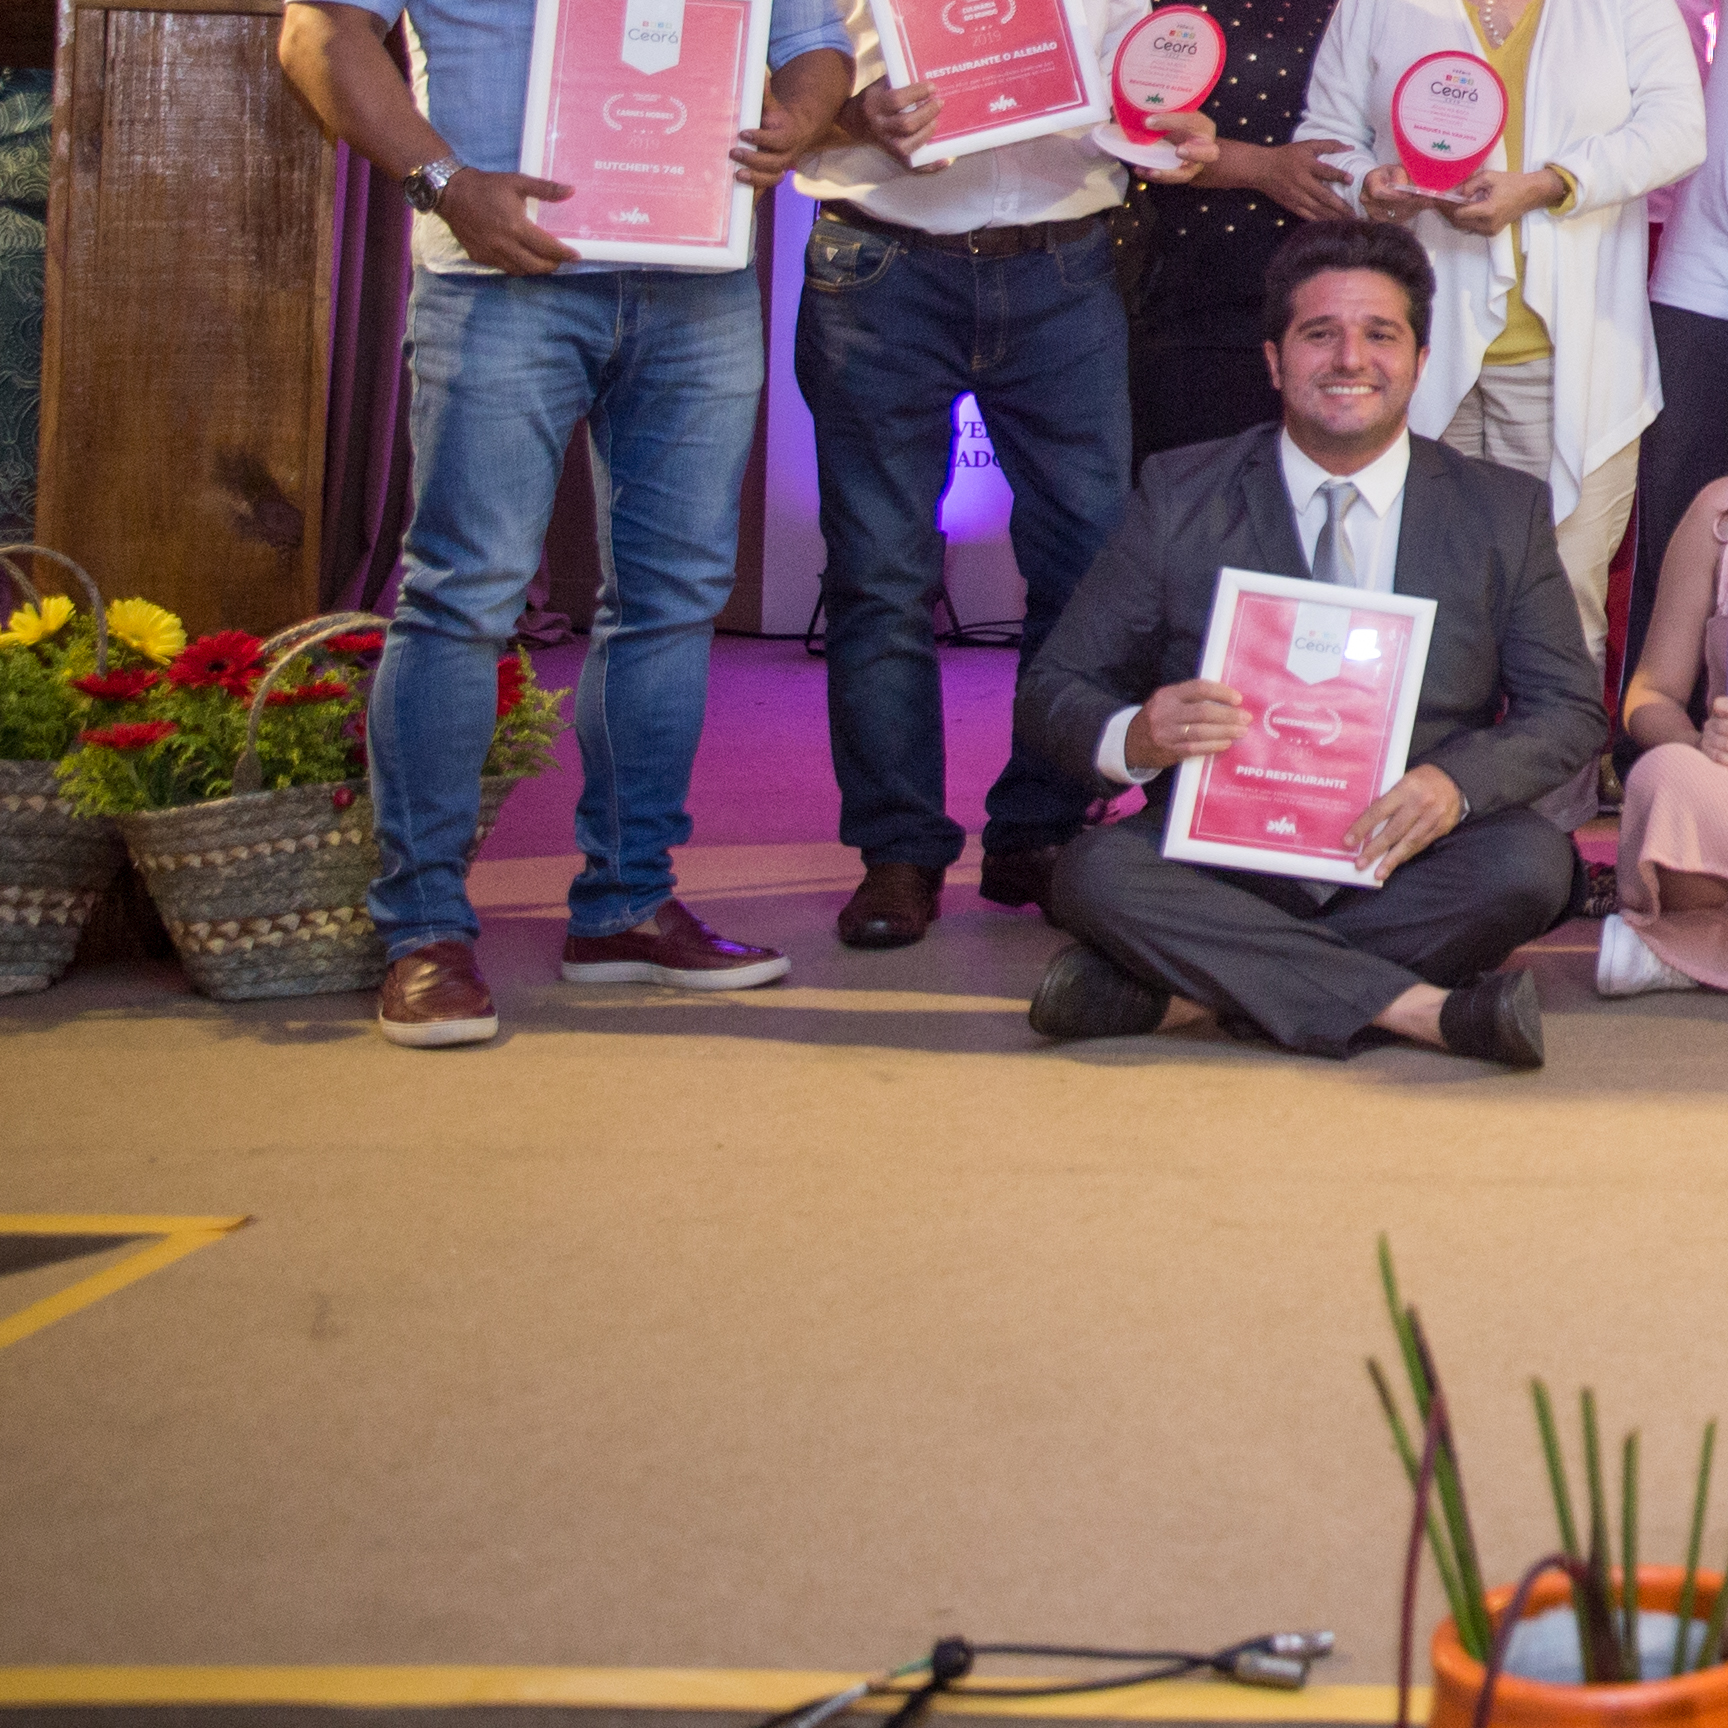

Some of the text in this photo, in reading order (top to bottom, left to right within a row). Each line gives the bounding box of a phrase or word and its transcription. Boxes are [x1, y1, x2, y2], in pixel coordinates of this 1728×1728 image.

[628, 27, 679, 45] Ceará
[1153, 37, 1198, 56] Ceará
[924, 55, 1001, 80] RESTAURANTE
[1012, 41, 1058, 60] ALEMÃO
[1431, 81, 1479, 103] Ceará
[594, 160, 686, 175] BUTCHER'S 746
[1235, 764, 1348, 791] PIPO RESTAURANTE
